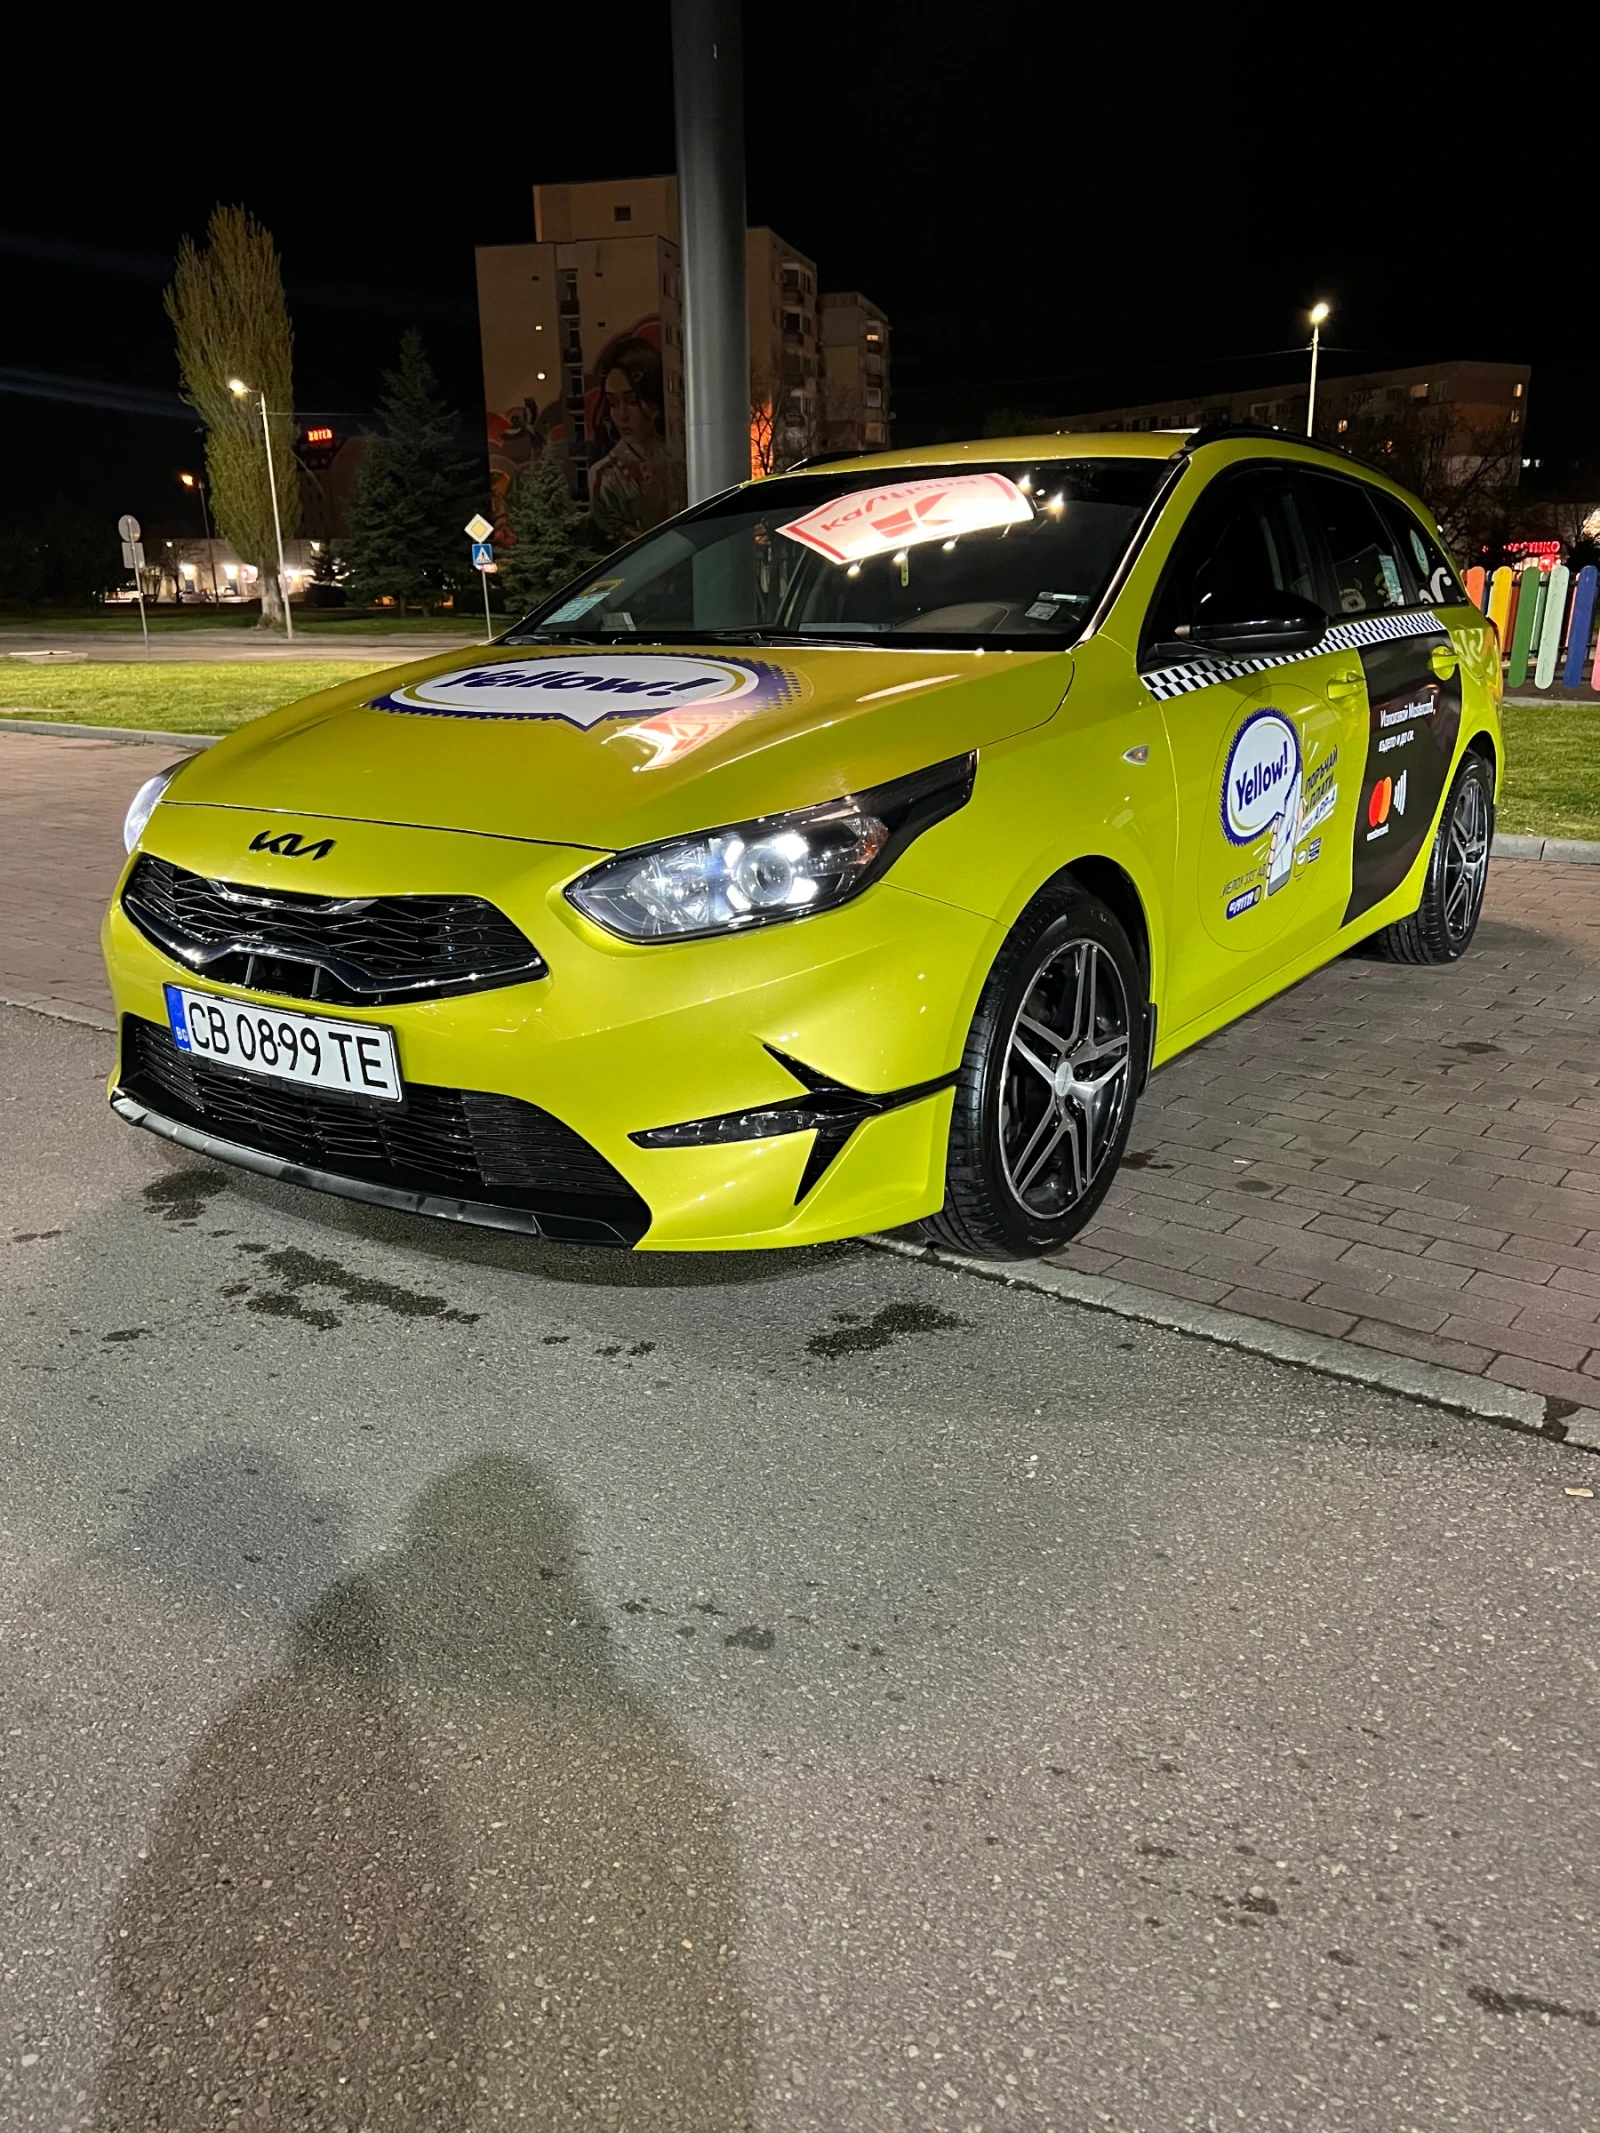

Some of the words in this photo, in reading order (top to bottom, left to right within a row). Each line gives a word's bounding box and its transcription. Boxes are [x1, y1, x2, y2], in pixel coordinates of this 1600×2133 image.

[432, 668, 726, 697] Yellow!
[1235, 741, 1288, 812] Yellow!
[1305, 744, 1339, 794] ПОРЪЧАЙ
[175, 1025, 189, 1043] BG
[189, 1003, 229, 1056] CB
[236, 1011, 322, 1077] 0899
[328, 1033, 389, 1090] TE
